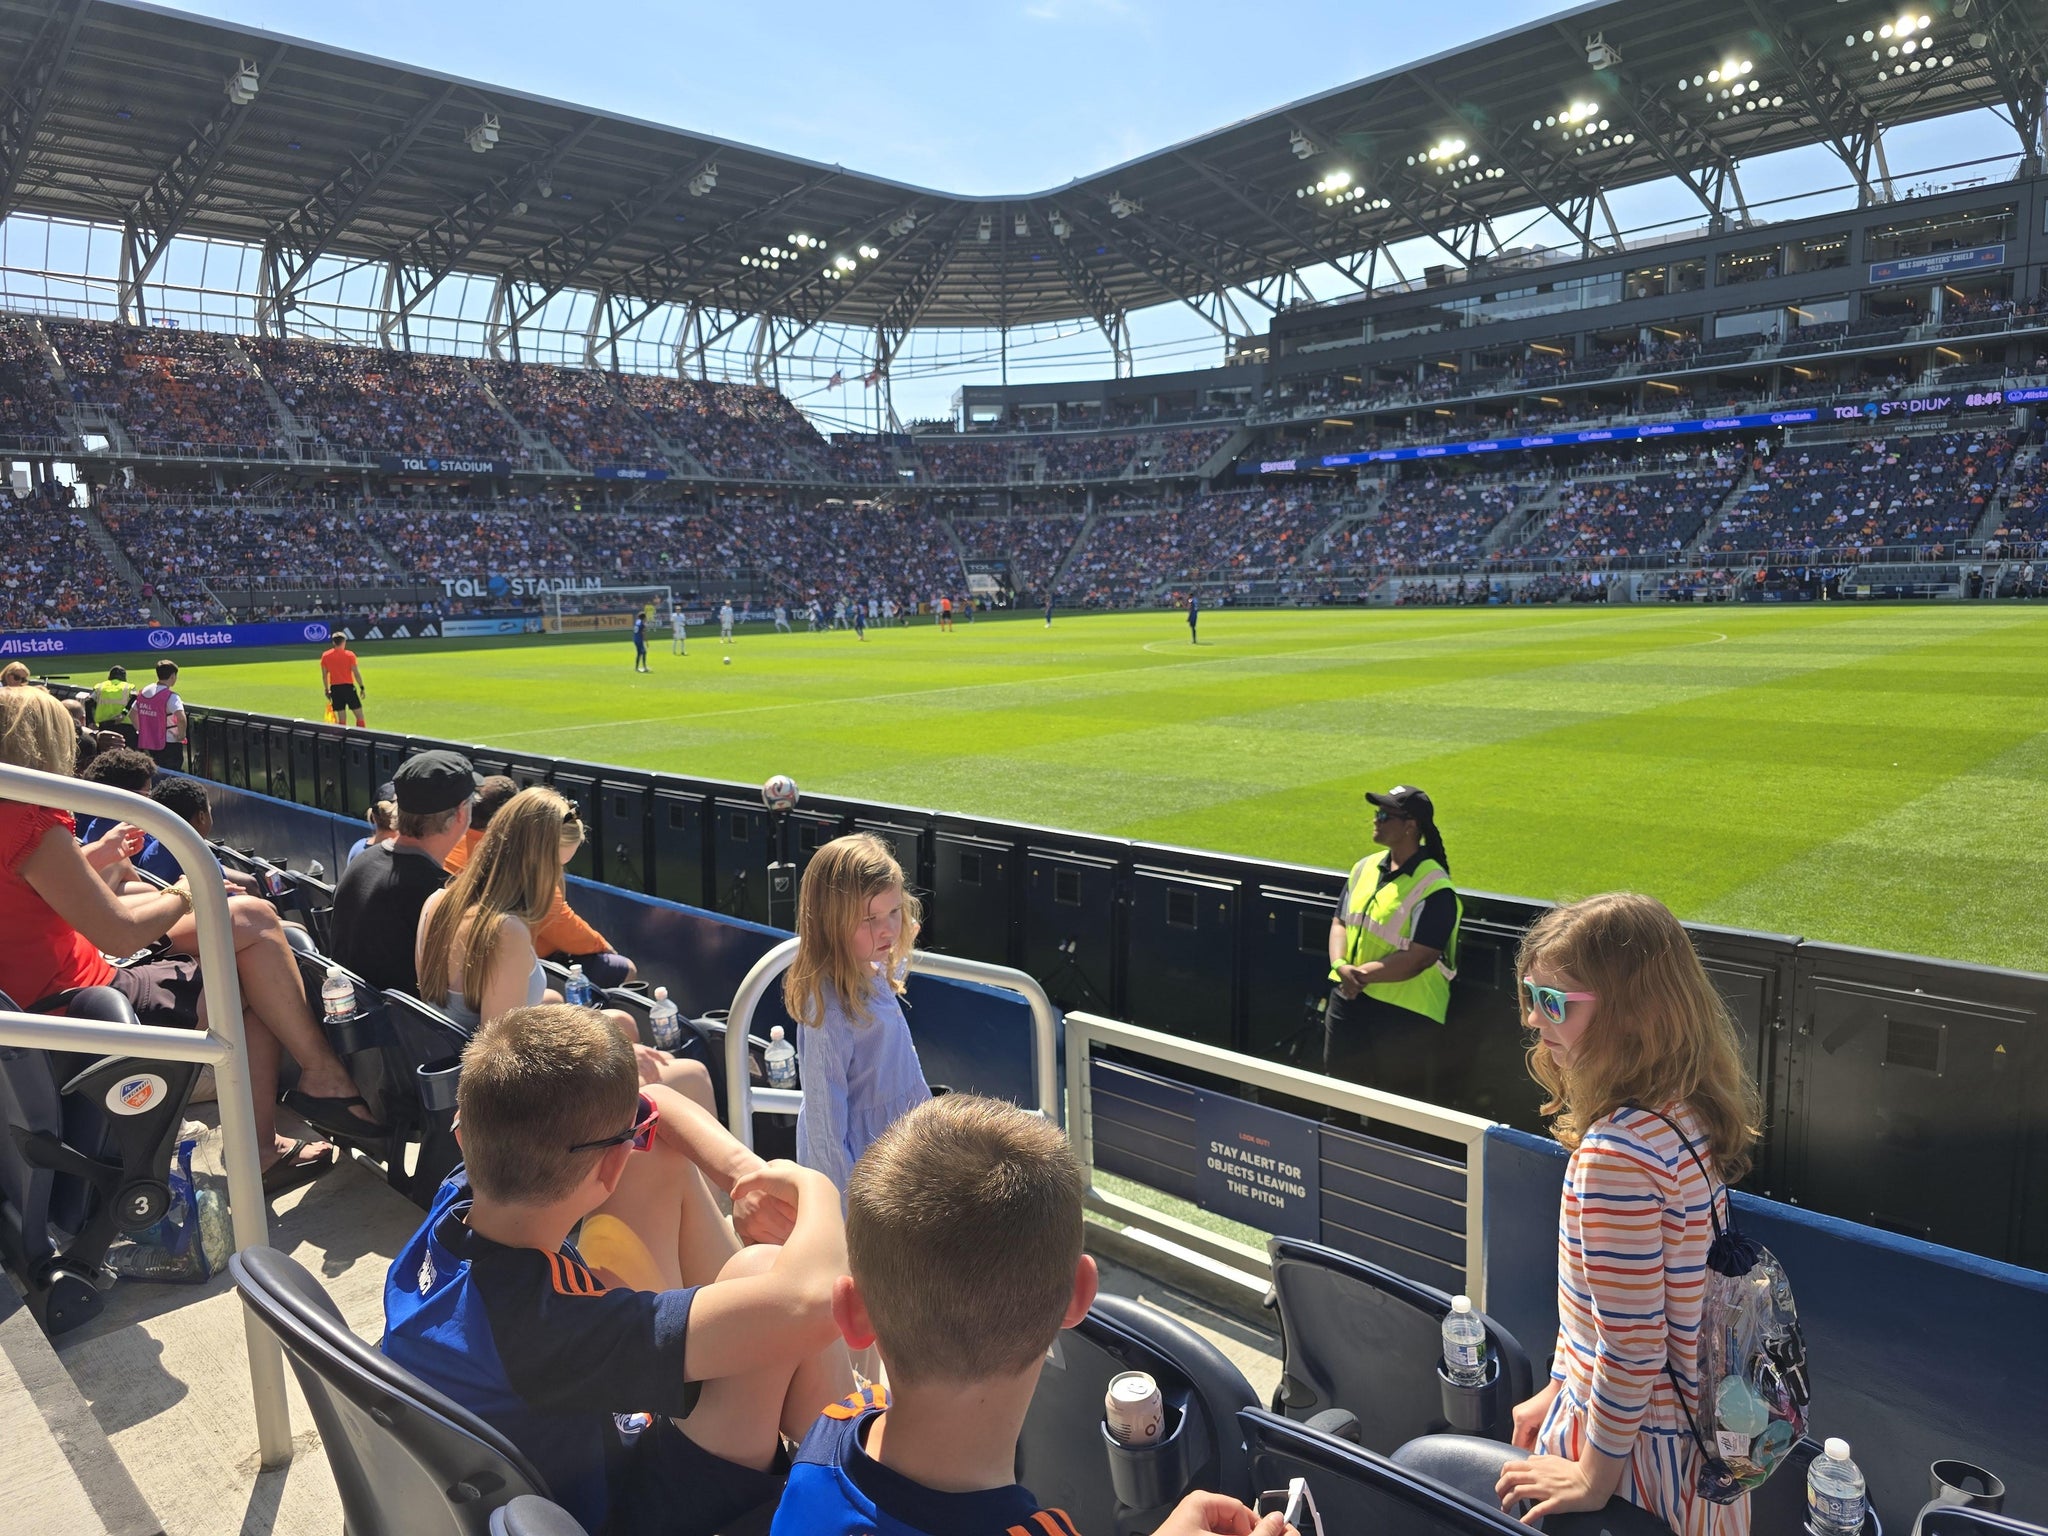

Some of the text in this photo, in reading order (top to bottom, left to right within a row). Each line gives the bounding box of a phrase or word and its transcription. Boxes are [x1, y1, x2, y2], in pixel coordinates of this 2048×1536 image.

[1833, 405, 1863, 419] TQL
[402, 458, 493, 473] TQL STADIUM
[441, 576, 602, 597] TQL STADIUM
[0, 638, 64, 654] Allstate
[176, 631, 233, 646] Allstate
[1210, 1141, 1302, 1180] STAY ALERT FOR
[1207, 1156, 1306, 1198] OBJECTS LEAVING
[1227, 1179, 1285, 1209] THE PITCH
[134, 1196, 150, 1215] 3
